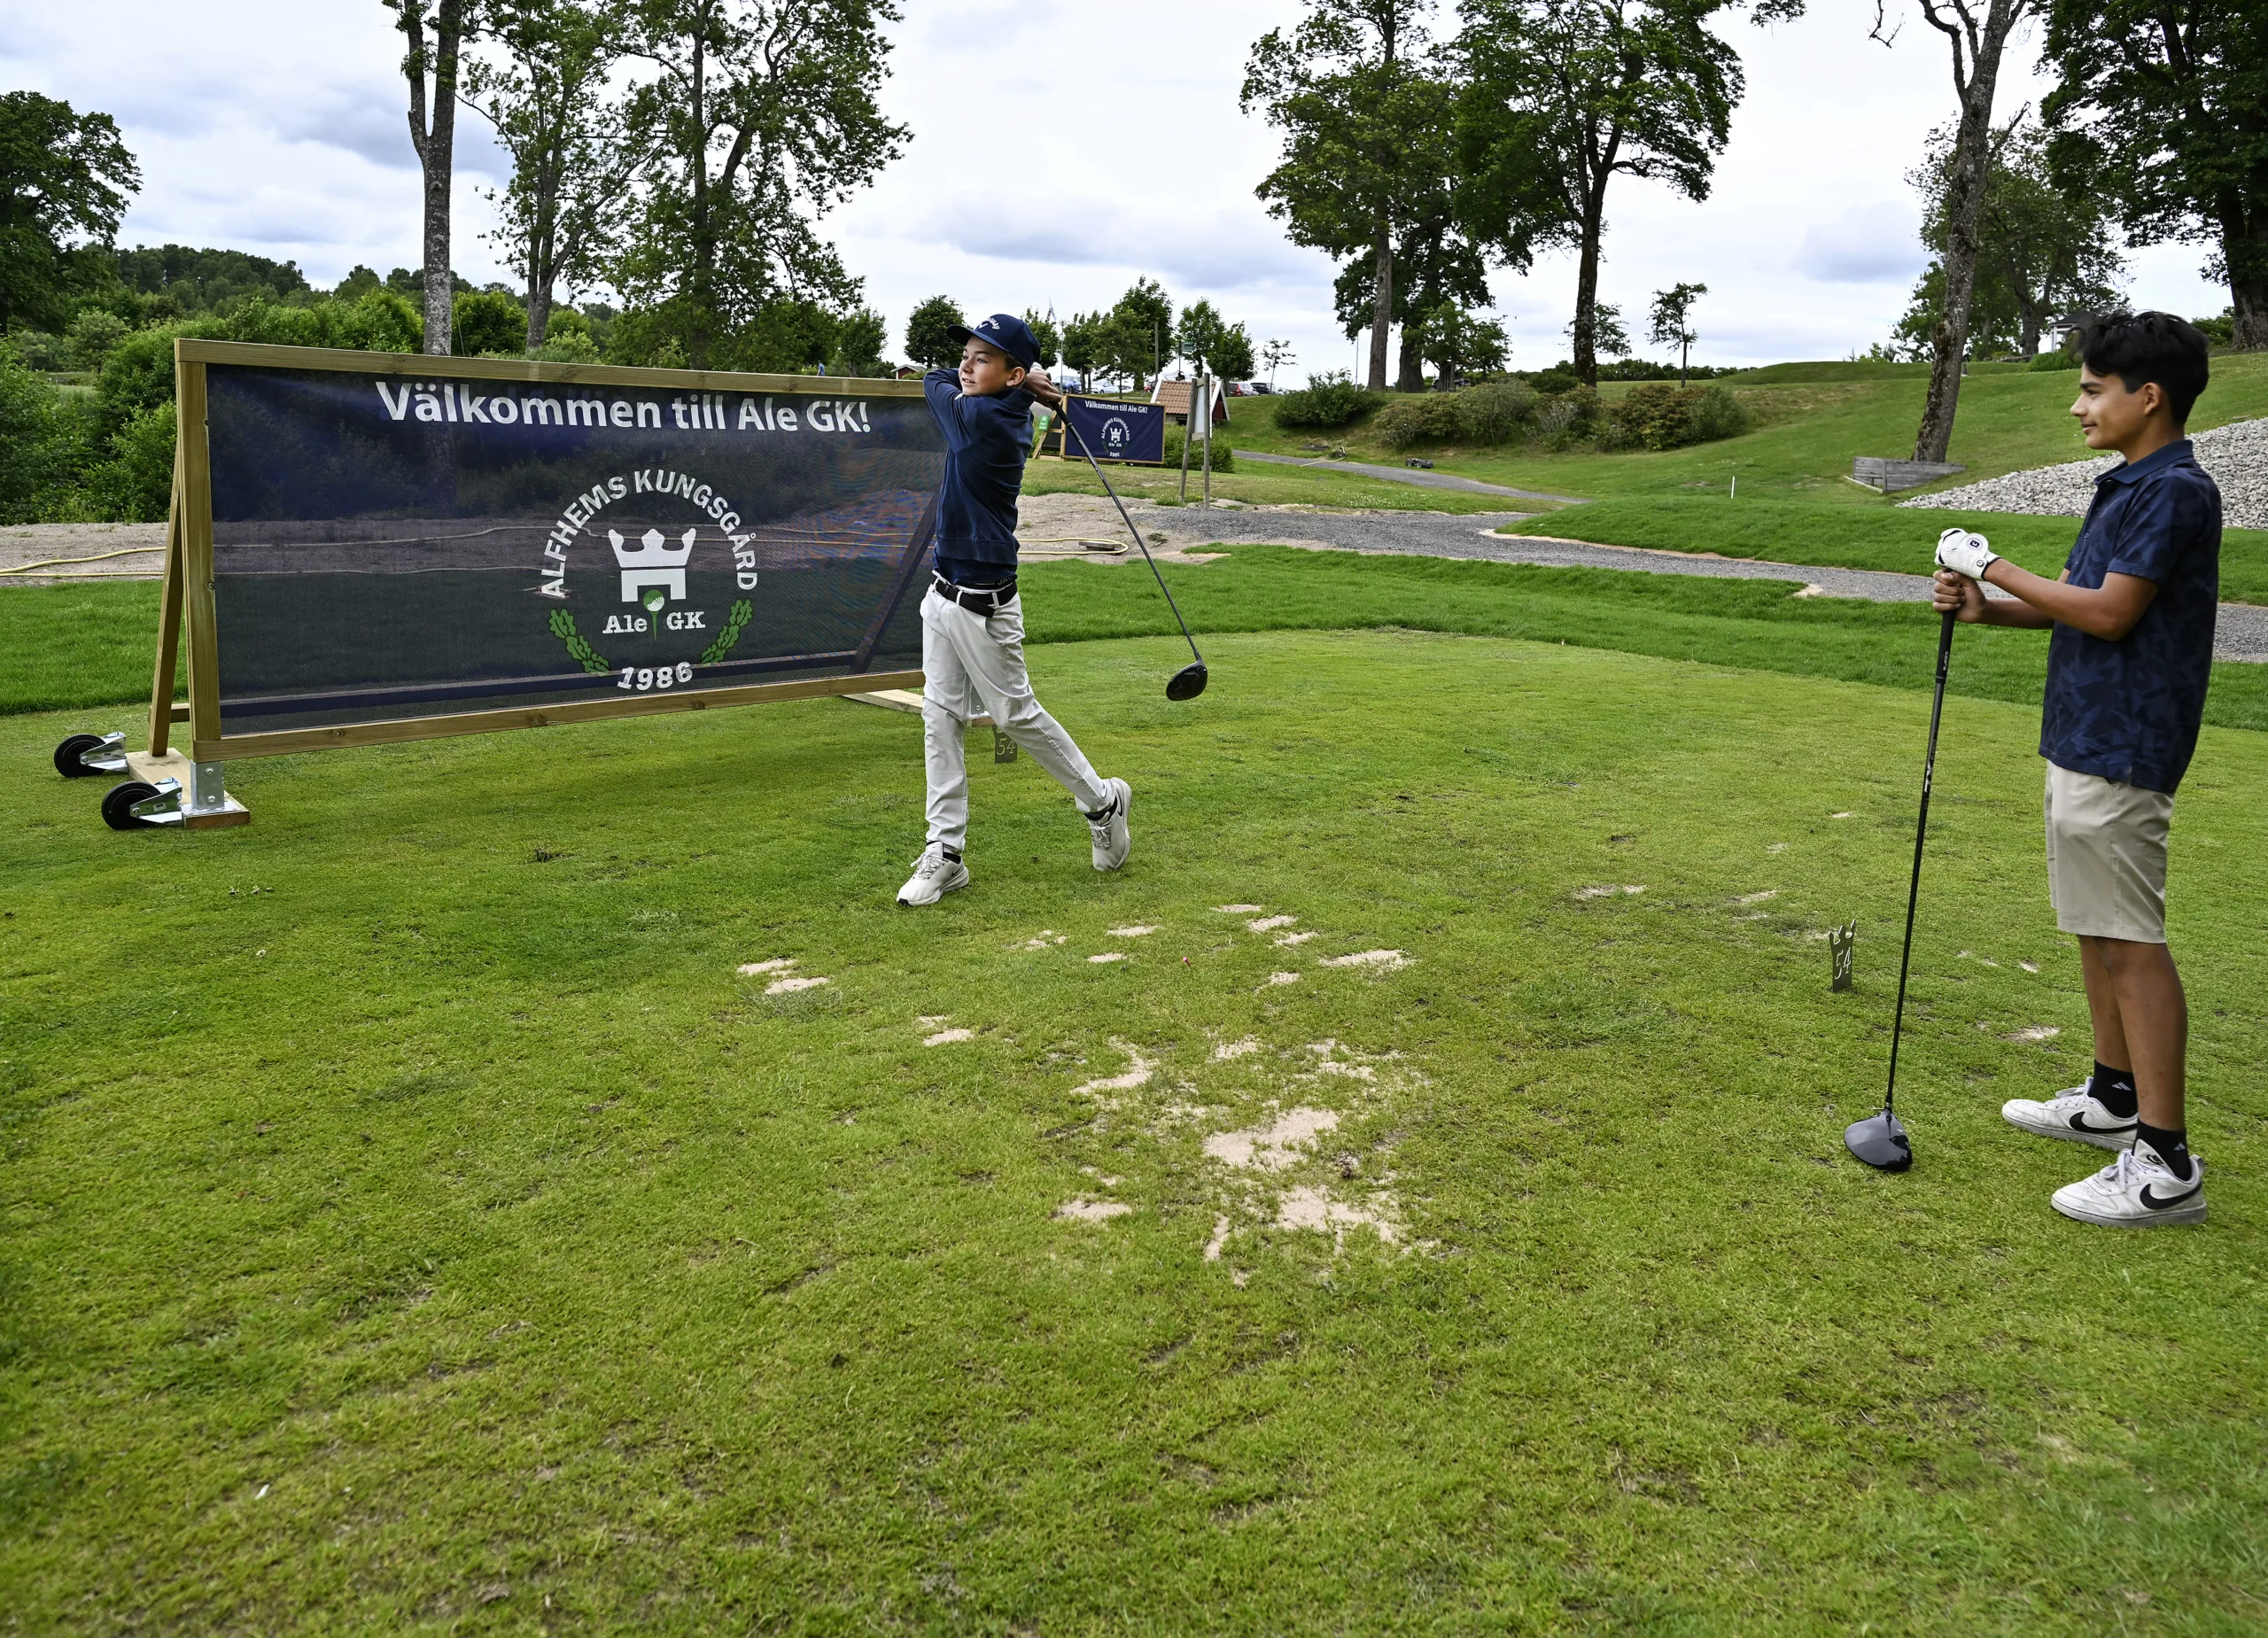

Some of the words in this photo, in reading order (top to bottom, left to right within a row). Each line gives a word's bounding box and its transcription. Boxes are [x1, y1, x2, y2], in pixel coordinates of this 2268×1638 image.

[376, 381, 663, 430] Välkommen
[672, 395, 726, 431] till
[737, 397, 798, 433] Ale
[805, 400, 872, 434] GK!
[1085, 400, 1119, 411] Välkommen
[541, 474, 628, 598] ALFHEMS
[634, 469, 757, 591] KUNGSGÅRD
[602, 614, 649, 635] Ale
[666, 610, 706, 632] GK
[617, 661, 693, 691] 1986
[997, 736, 1016, 756] 54
[1834, 945, 1852, 980] 54
